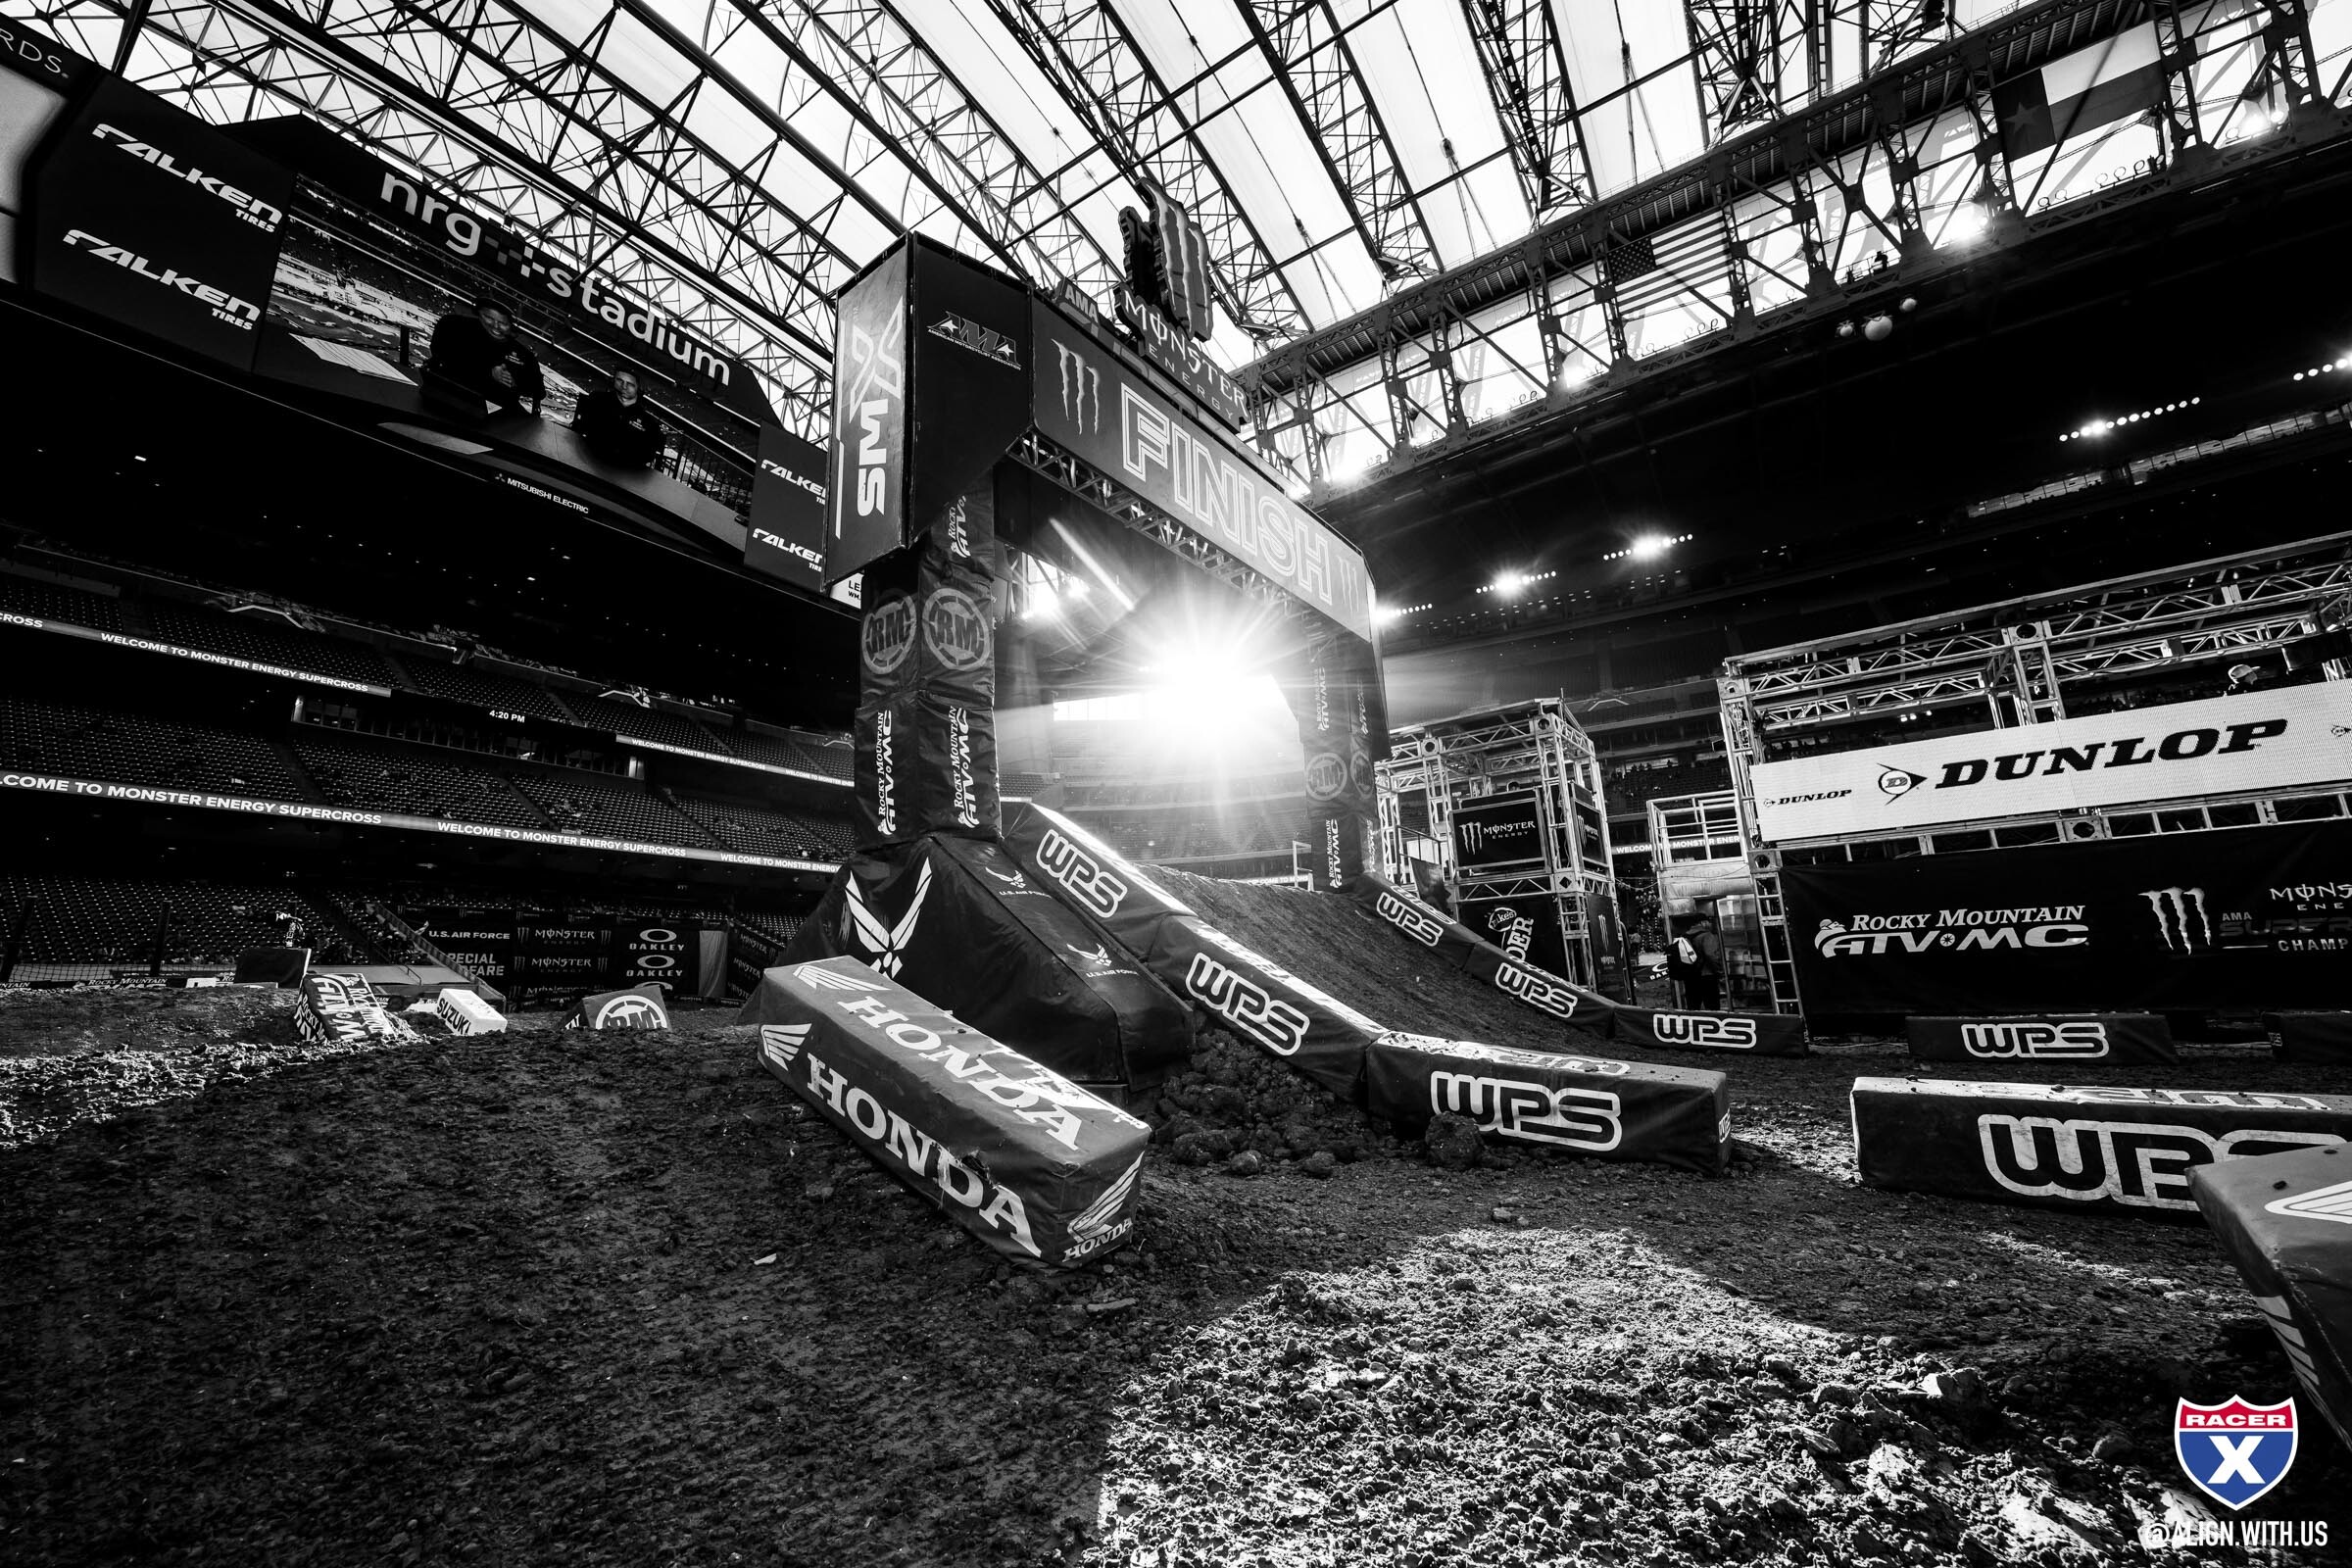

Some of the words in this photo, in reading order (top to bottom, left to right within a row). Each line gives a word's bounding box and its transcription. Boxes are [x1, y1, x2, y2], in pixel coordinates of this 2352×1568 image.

[92, 123, 282, 224] FALKEN
[235, 209, 275, 233] TIRES
[63, 229, 260, 322] FALKEN
[380, 172, 482, 257] nrg
[545, 266, 731, 386] stadium
[212, 308, 253, 330] TIRES
[1065, 284, 1100, 323] AMA
[1124, 290, 1250, 418] MONSTER
[1149, 343, 1234, 420] ENERGY
[507, 477, 552, 501] MITSUBISHI
[553, 495, 589, 514] ELECTRIC
[1120, 381, 1333, 606] FINISH
[101, 632, 168, 654] WELCOME
[171, 646, 188, 657] TO
[190, 651, 250, 670] MONSTER
[252, 662, 297, 678] ENERGY
[299, 672, 368, 692] SUPERCROSS
[489, 710, 510, 720] 4:20
[511, 713, 525, 723] PM
[632, 739, 664, 751] WELCOME
[675, 747, 705, 759] MONSTER
[875, 711, 884, 775] MOUNTAIN
[948, 706, 960, 769] MOUNTAIN
[1935, 718, 2288, 789] DUNLOP
[0, 774, 70, 792] COME
[74, 781, 103, 795] TO
[107, 785, 202, 806] MONSTER
[206, 796, 276, 813] ENERGY
[278, 805, 382, 824] SUPERCROSS
[954, 769, 965, 809] ROCKY
[1777, 789, 1852, 806] DUNLOP
[437, 821, 502, 838] WELCOME
[504, 828, 520, 840] TO
[522, 831, 577, 846] MONSTER
[579, 837, 622, 850] ENERGY
[623, 842, 686, 857] SUPERCROSS
[1483, 820, 1536, 835] MONSTER
[720, 853, 761, 864] WELCOME
[762, 858, 774, 866] TO
[774, 858, 811, 871] MONSTER
[811, 863, 842, 872] ENERGY
[1616, 844, 1652, 854] WELCOM
[1036, 828, 1128, 919] WPS
[534, 927, 596, 940] MONSTER
[1376, 891, 1445, 948] WPS
[1850, 913, 1931, 931] ROCKY
[1936, 906, 2085, 927] MOUNTAIN
[2222, 911, 2253, 922] AMA
[447, 953, 497, 964] PECIAL
[530, 956, 592, 968] MONSTER
[628, 942, 686, 952] OAKLEY
[2277, 938, 2349, 953] CHAMP
[1186, 952, 1310, 1055] WPS
[1494, 961, 1579, 1018] WPS
[436, 998, 471, 1035] SUZUKI
[1653, 1013, 1757, 1049] WPS
[1961, 1022, 2110, 1058] WPS
[836, 996, 1083, 1151] HONDA
[1431, 1070, 1623, 1152] WPS
[807, 1052, 1042, 1257] HONDA
[1062, 1217, 1134, 1263] HONDA
